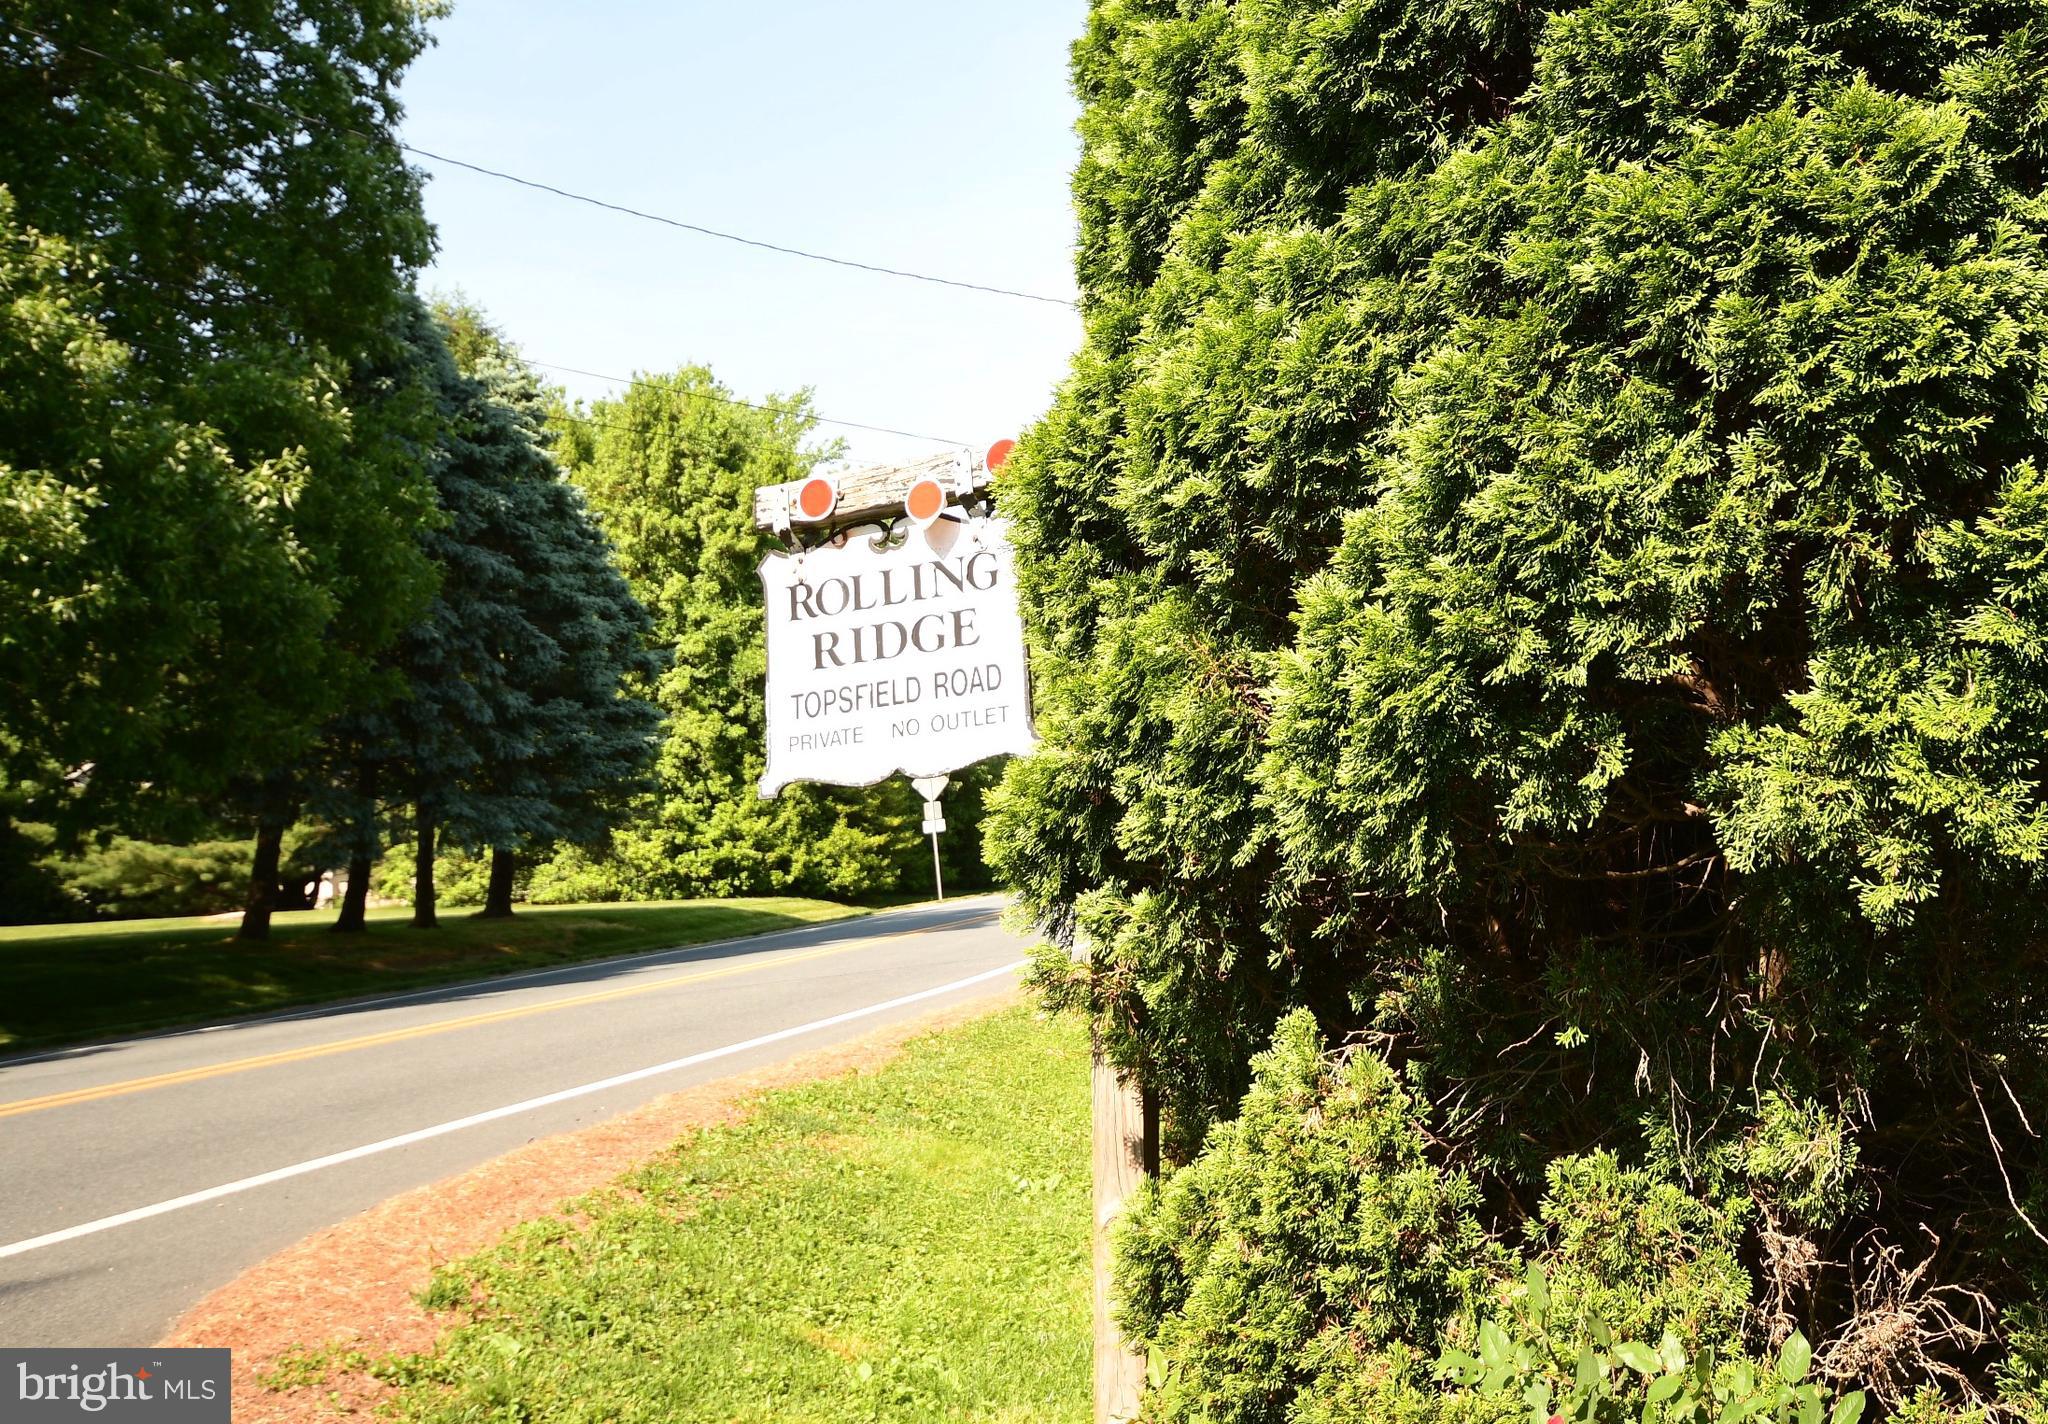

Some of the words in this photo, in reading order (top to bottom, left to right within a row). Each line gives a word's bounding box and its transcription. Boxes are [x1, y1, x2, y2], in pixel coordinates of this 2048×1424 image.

[785, 552, 999, 621] ROLLING
[812, 608, 981, 670] RIDGE
[790, 676, 921, 720] TOPSFIELD
[934, 663, 1001, 699] ROAD
[789, 726, 864, 751] PRIVATE
[892, 718, 920, 738] NO
[931, 705, 1009, 733] OUTLET
